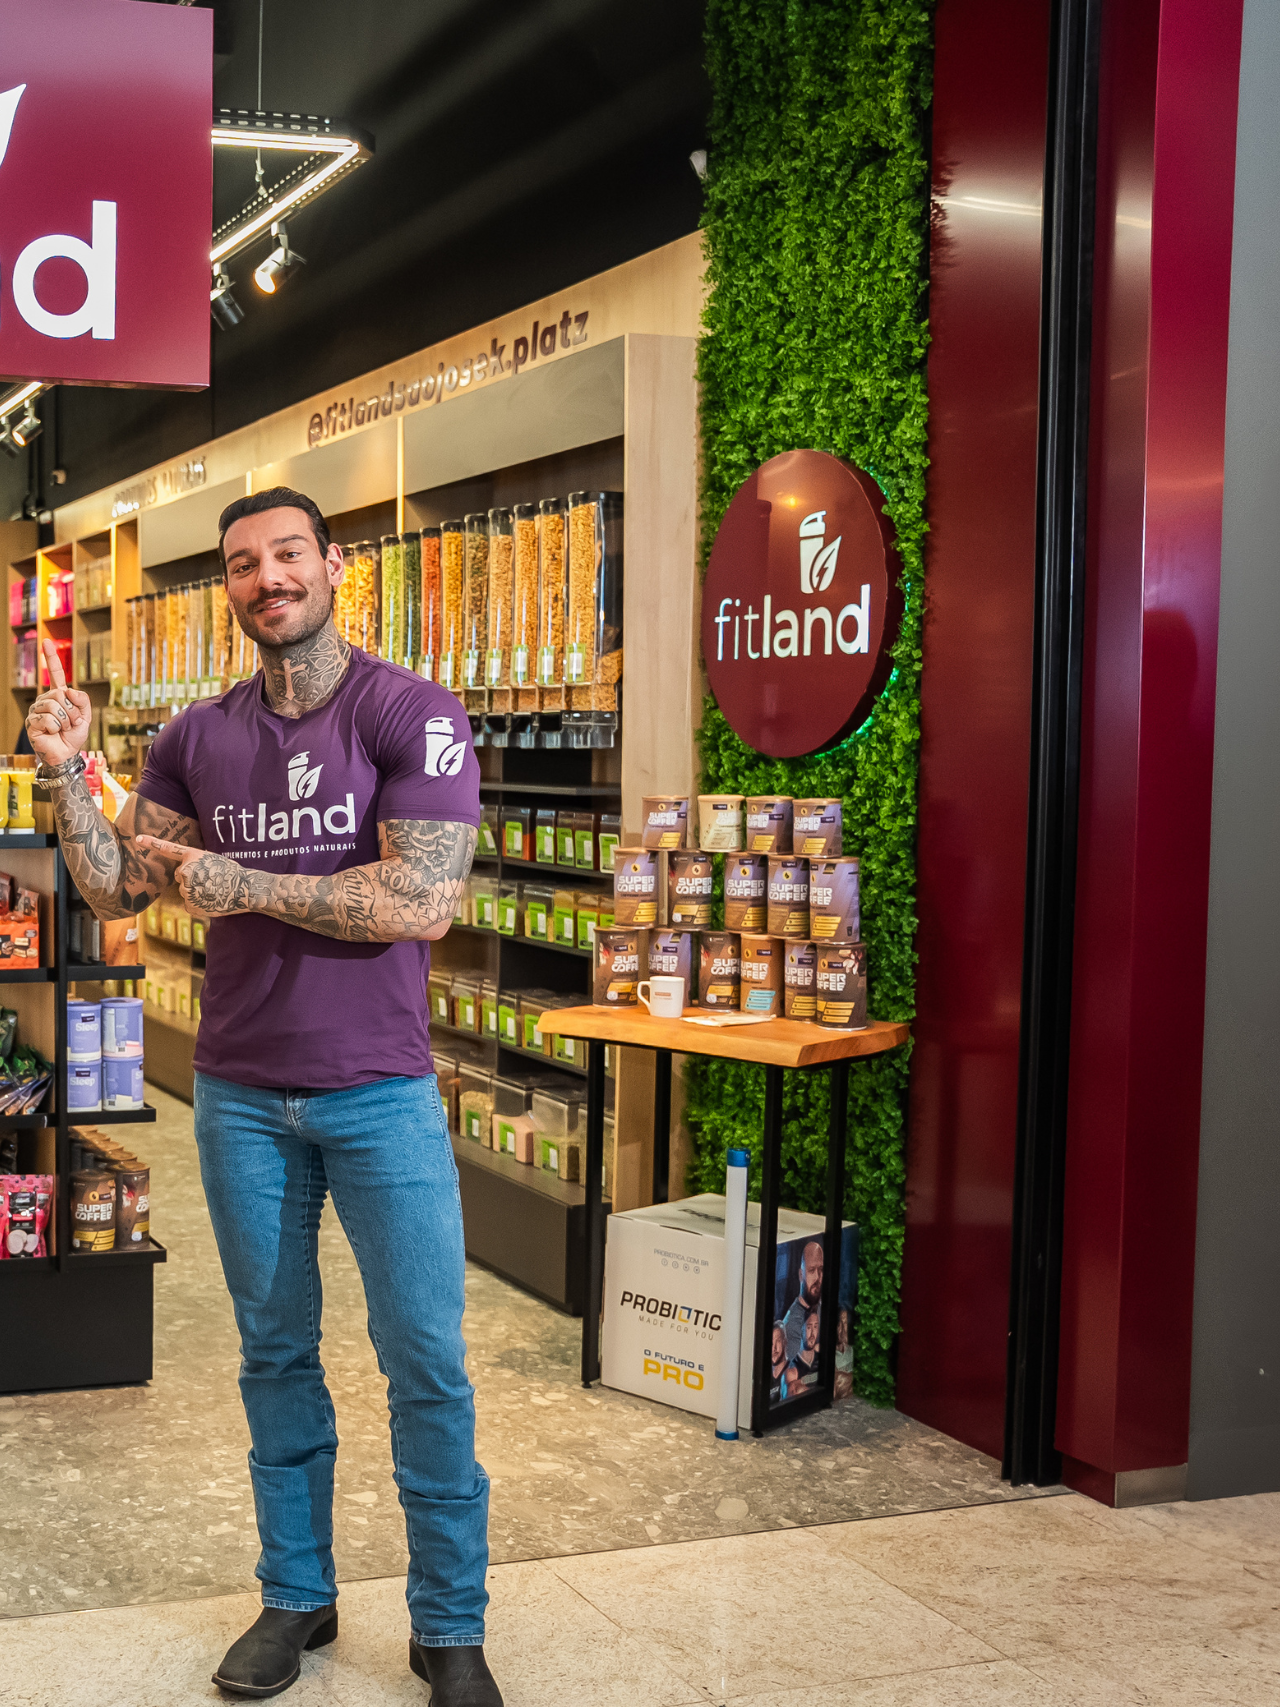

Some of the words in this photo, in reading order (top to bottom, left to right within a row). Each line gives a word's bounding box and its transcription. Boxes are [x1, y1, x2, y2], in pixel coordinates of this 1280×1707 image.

[308, 310, 589, 449] @fitlandsaojosek.platz
[713, 583, 871, 662] fitland
[212, 792, 357, 843] fitland
[649, 812, 678, 820] SUPER
[271, 845, 310, 857] PRODUTOS
[313, 842, 357, 852] NATURAIS
[618, 876, 655, 885] SUPER
[677, 877, 713, 887] SUPER
[727, 880, 765, 889] SUPER
[769, 883, 809, 893] SUPER
[810, 887, 833, 897] PER
[741, 961, 769, 972] UPER
[785, 967, 814, 977] UPER
[816, 972, 847, 983] UPER
[75, 1022, 99, 1032] Sleep
[69, 1077, 95, 1087] Sleep
[77, 1202, 113, 1213] SUPER
[75, 1211, 113, 1222] COFFEE
[620, 1290, 722, 1332] PROBIOTIC
[638, 1315, 665, 1328] MADE
[669, 1322, 689, 1334] FOR
[694, 1329, 715, 1341] YOU
[643, 1348, 652, 1357] O
[654, 1351, 695, 1369] FUTURO
[643, 1358, 705, 1391] PRO
